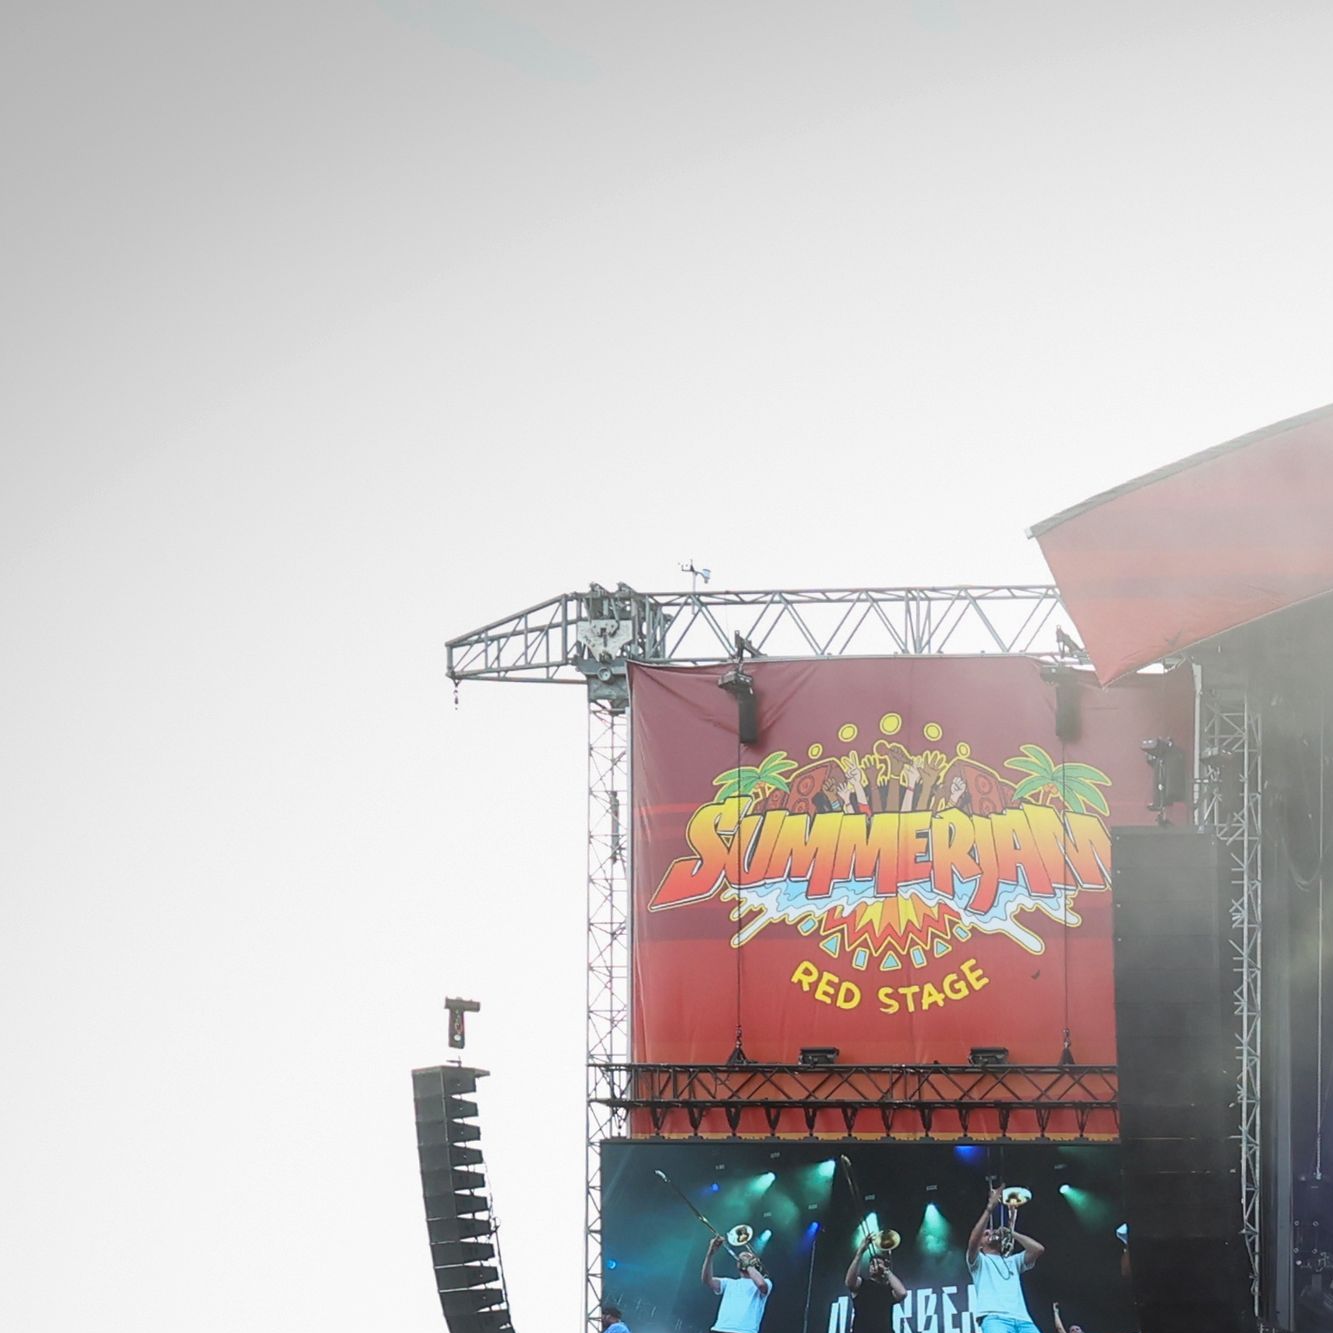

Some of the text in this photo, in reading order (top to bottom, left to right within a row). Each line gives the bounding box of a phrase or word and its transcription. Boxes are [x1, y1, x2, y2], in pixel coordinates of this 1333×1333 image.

[648, 795, 1111, 914] SUMMERJAM
[791, 958, 990, 1014] RED STAGE
